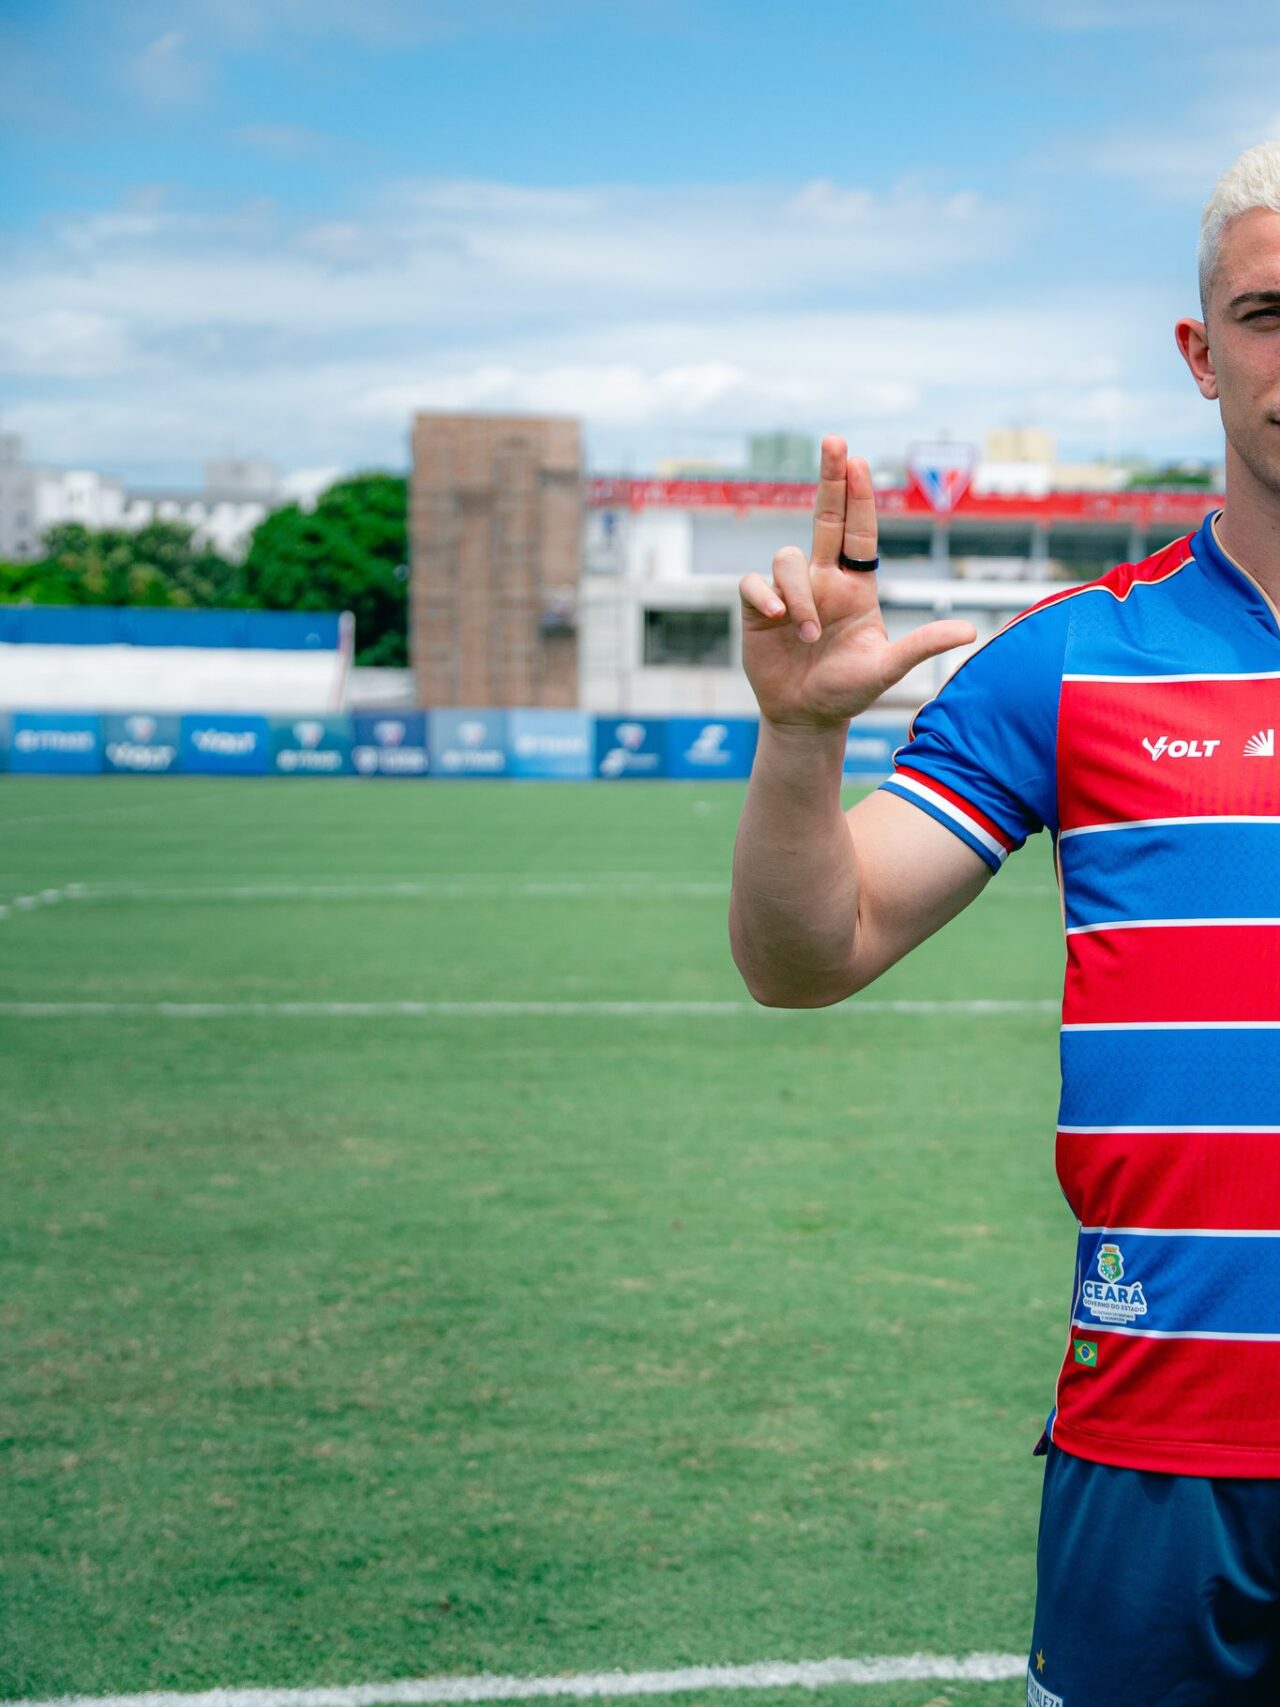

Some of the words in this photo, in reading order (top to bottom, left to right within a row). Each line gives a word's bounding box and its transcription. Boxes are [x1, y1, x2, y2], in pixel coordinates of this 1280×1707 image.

[1142, 736, 1220, 761] VOLT
[1084, 1281, 1144, 1305] CEARÁ
[1084, 1299, 1110, 1309] GOVERNO
